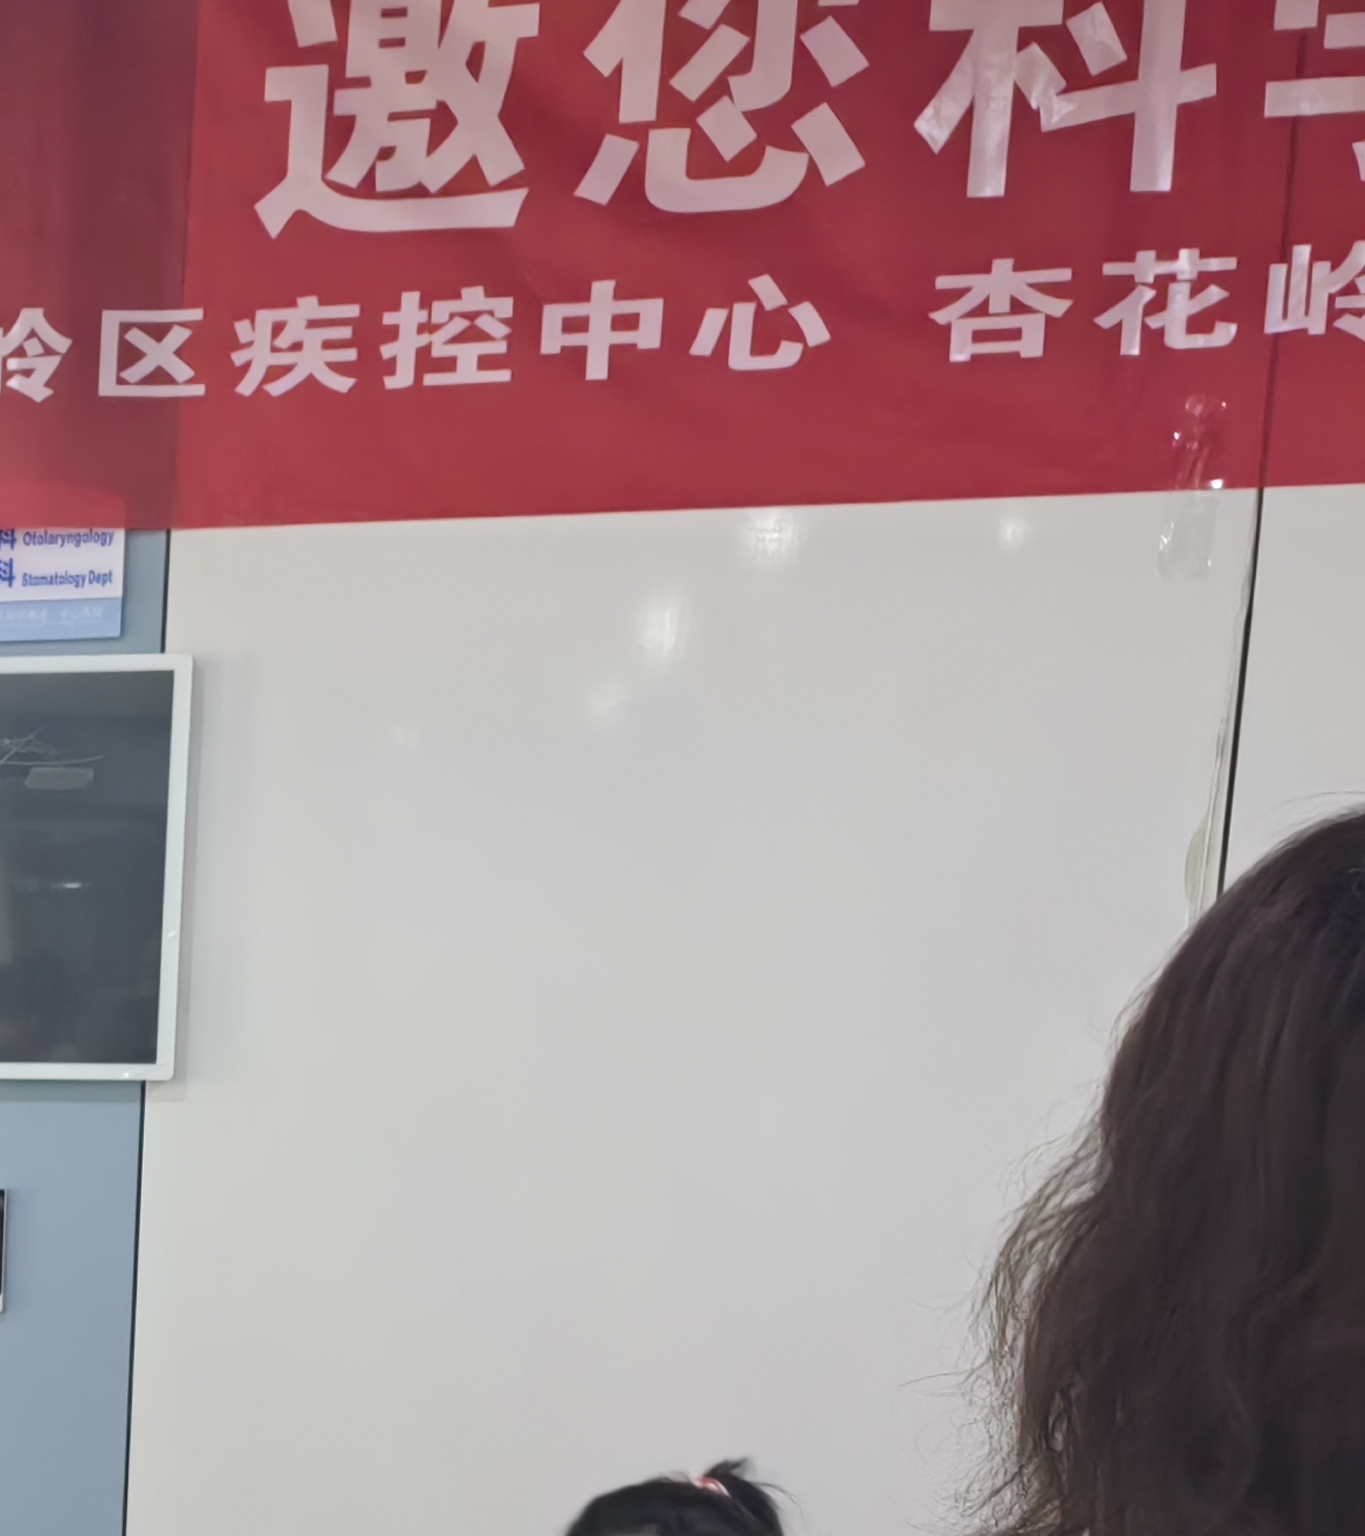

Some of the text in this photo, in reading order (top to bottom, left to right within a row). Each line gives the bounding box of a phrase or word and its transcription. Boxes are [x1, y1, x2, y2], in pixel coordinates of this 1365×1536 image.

[23, 529, 115, 547] Otolaryngology
[22, 571, 86, 588] Stomatology
[88, 570, 113, 587] Dept
